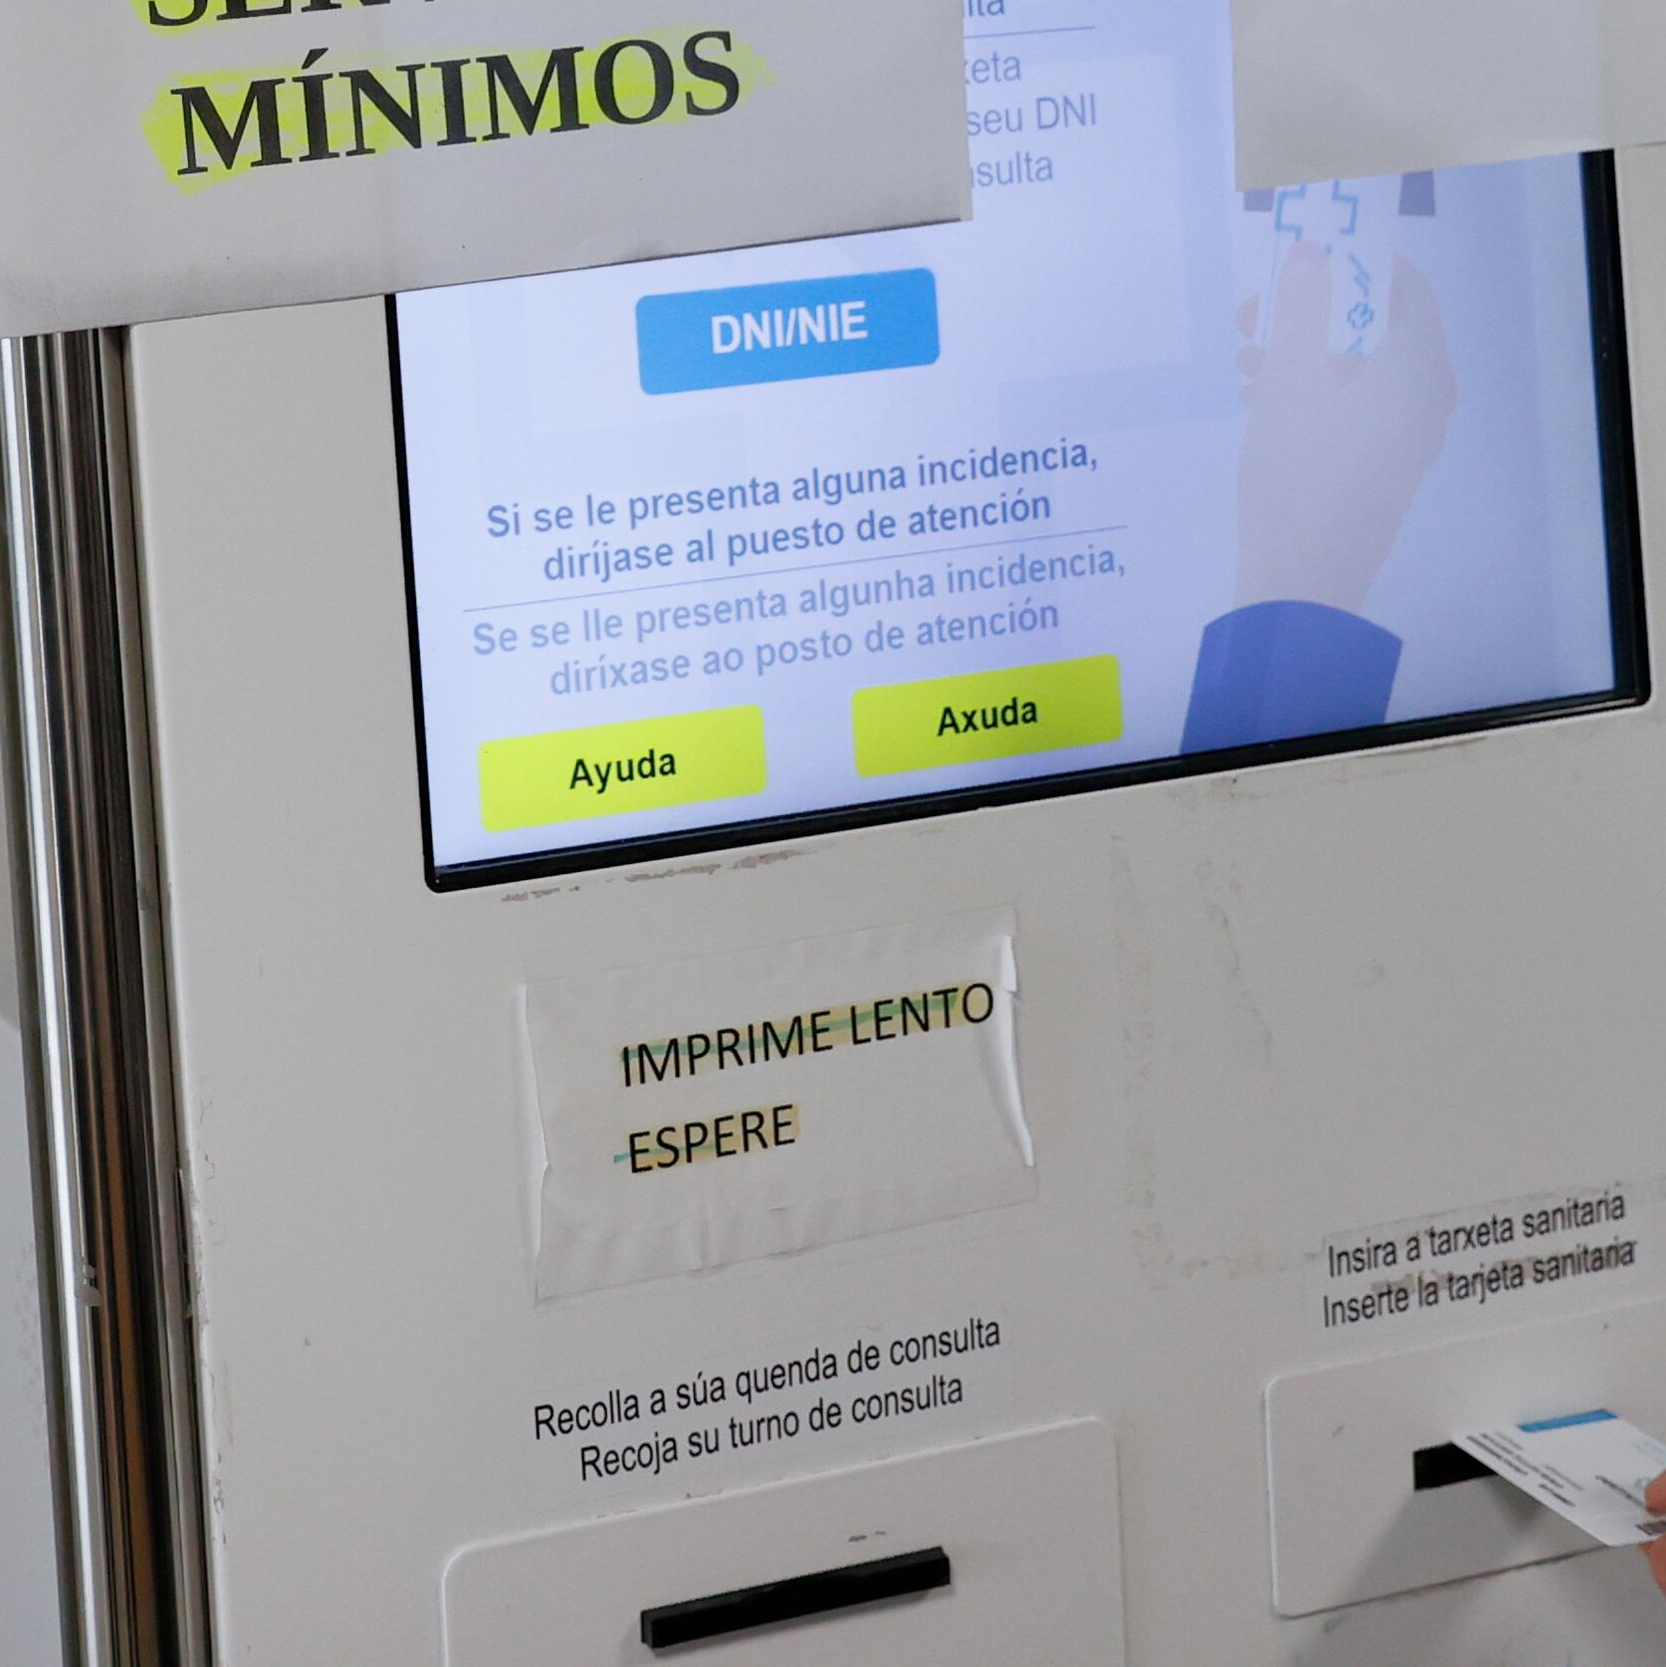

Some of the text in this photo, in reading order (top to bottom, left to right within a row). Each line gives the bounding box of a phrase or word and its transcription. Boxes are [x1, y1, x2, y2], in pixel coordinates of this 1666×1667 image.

[173, 30, 741, 176] MÍNIMOS
[967, 93, 1096, 136] seu DNI
[711, 301, 867, 355] DNI/NIE
[487, 440, 1099, 538] Si se le presenta alguna incidencia,
[544, 489, 1050, 588] diríjase al puesto de atención
[473, 543, 1126, 657] Se se lle presenta algunha incidencia,
[549, 598, 1060, 697] diríxase ao posto de atención
[937, 696, 1038, 736] Axuda
[569, 747, 677, 796] Ayuda
[622, 981, 994, 1087] IMPRIME LENTO
[628, 1104, 795, 1173] ESPERE
[1328, 1188, 1625, 1277] Insira a tarxeta sanitaria
[1323, 1239, 1636, 1327] Inserte la tarjeta sanitaria
[534, 1316, 1001, 1440] Recolla a súa quenda de consulta
[580, 1375, 963, 1481] Recoja su turno de consulta
